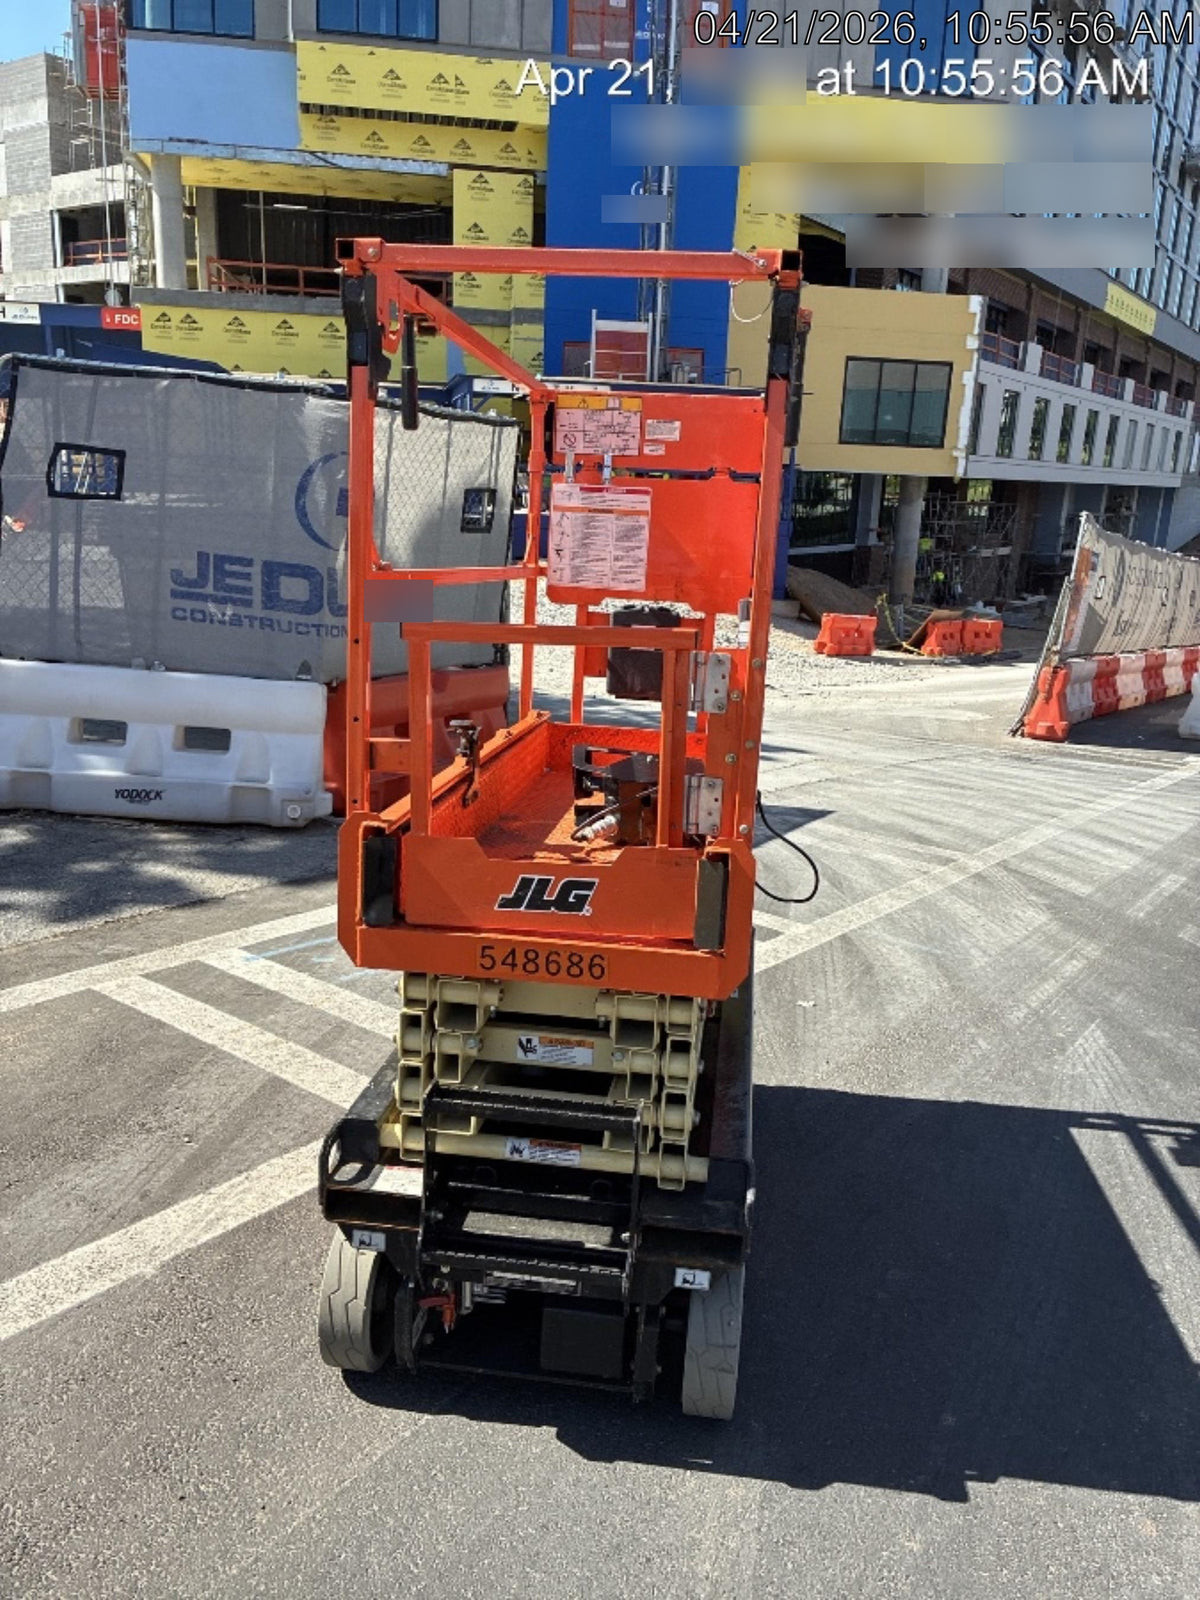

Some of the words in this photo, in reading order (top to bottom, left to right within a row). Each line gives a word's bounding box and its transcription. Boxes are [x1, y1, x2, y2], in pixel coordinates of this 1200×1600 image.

[114, 314, 139, 325] FDC
[114, 788, 165, 801] YODOCK
[493, 873, 599, 915] JLG
[479, 945, 606, 980] 548686
